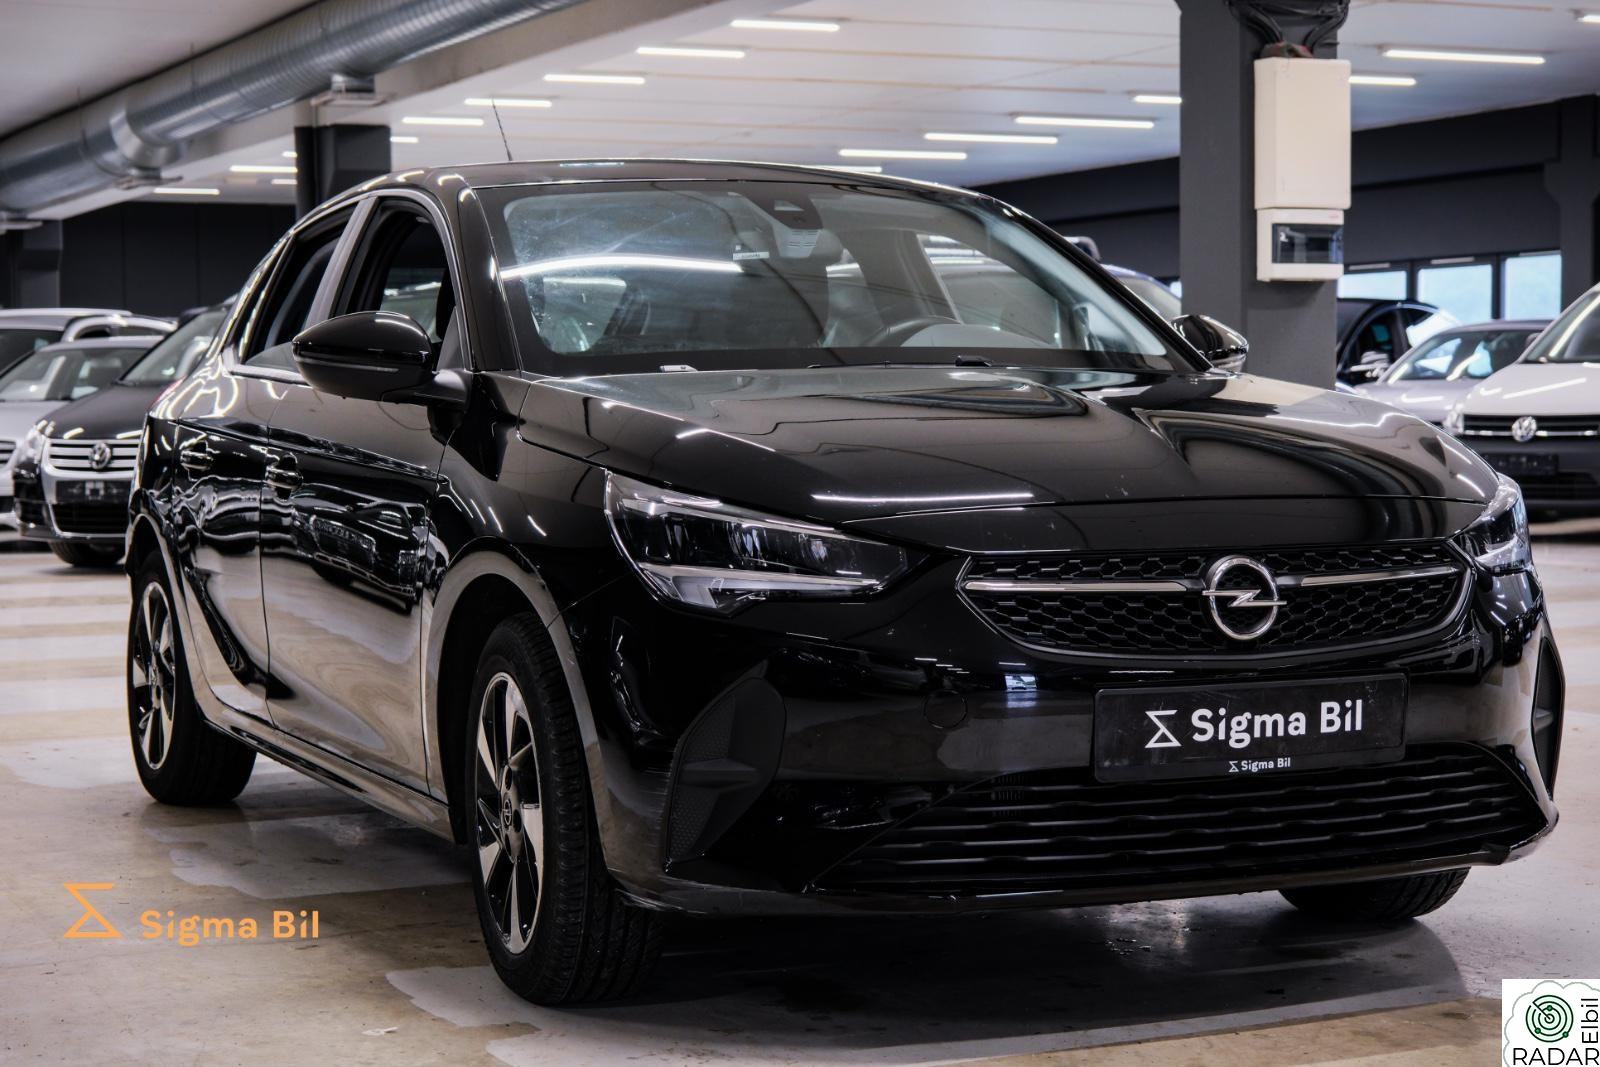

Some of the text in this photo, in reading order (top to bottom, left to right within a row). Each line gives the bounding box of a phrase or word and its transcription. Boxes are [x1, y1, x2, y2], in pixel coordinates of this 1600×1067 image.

[1191, 699, 1363, 748] Sigma Bil
[1240, 757, 1291, 773] Sigma Bil
